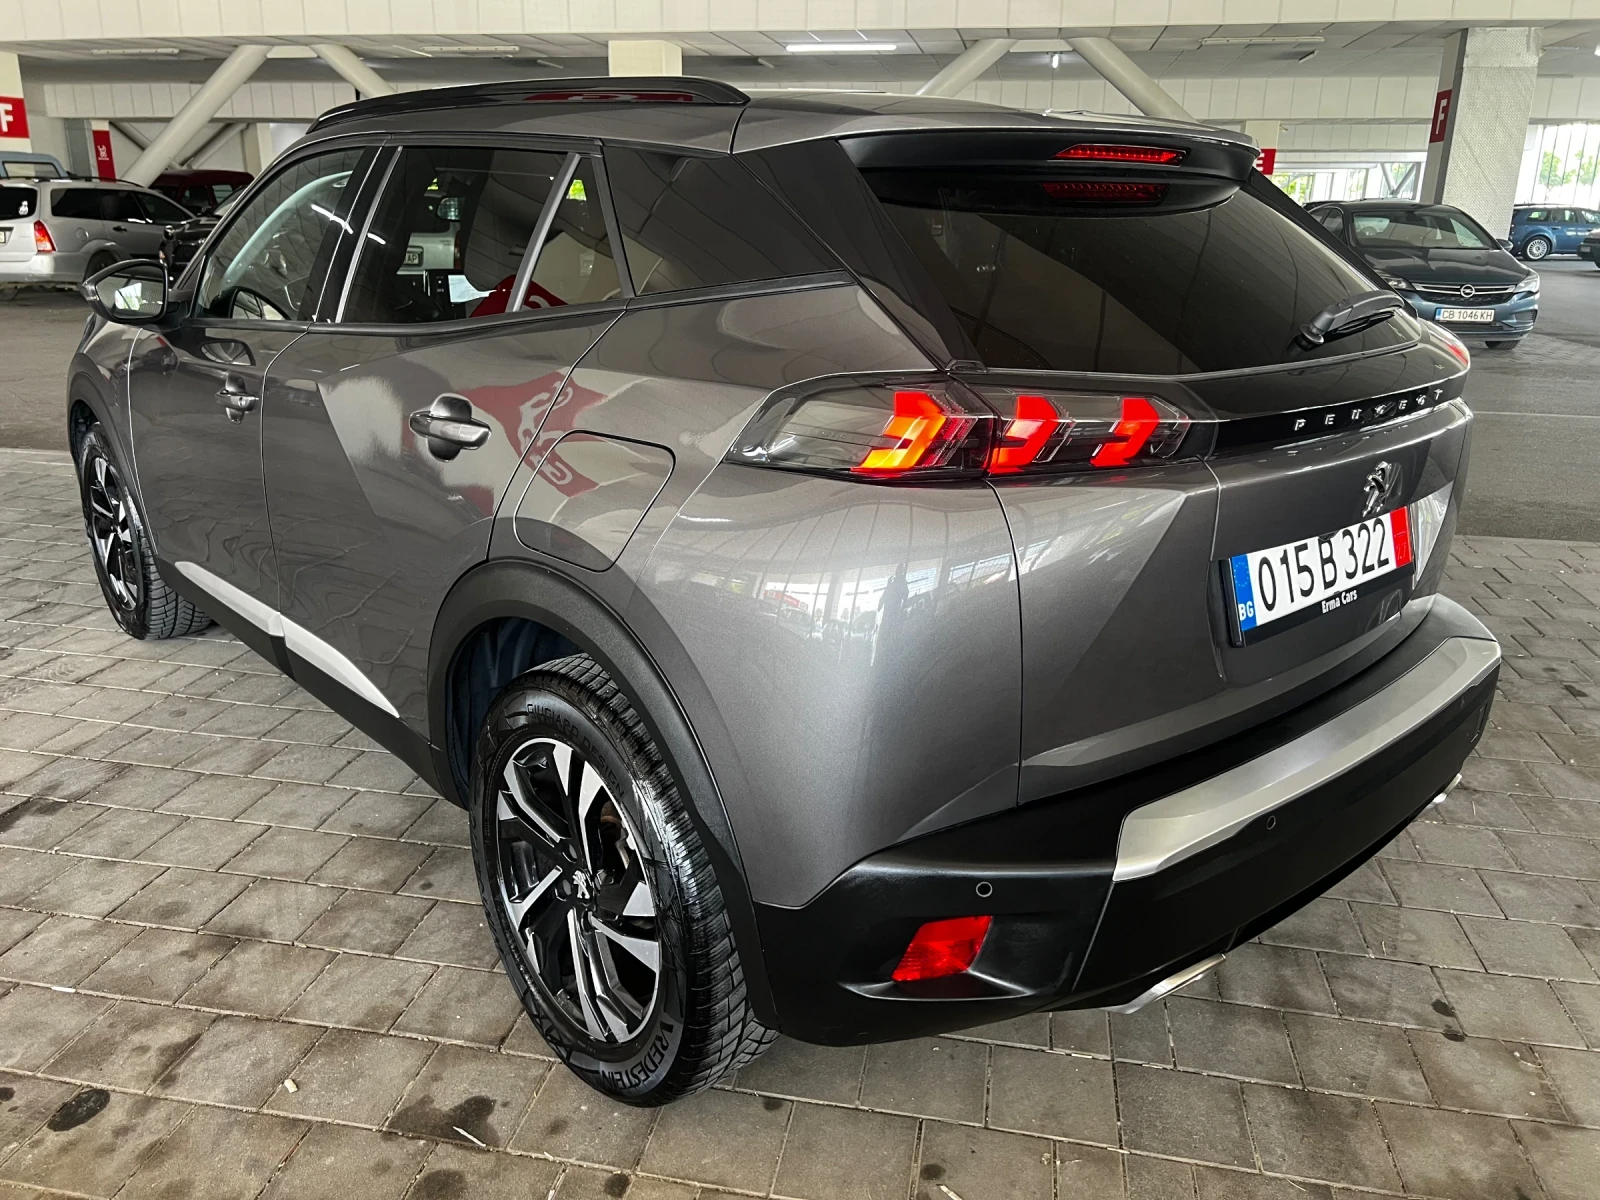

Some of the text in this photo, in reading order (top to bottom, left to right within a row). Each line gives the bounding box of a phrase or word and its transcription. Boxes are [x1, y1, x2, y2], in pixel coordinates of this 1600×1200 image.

[0, 103, 13, 132] F
[1436, 98, 1448, 135] F
[1442, 310, 1493, 320] CB 1046 KH
[1238, 601, 1254, 621] BG
[1321, 589, 1358, 613] Erma Cars
[601, 1021, 675, 1089] VREDESTEIN
